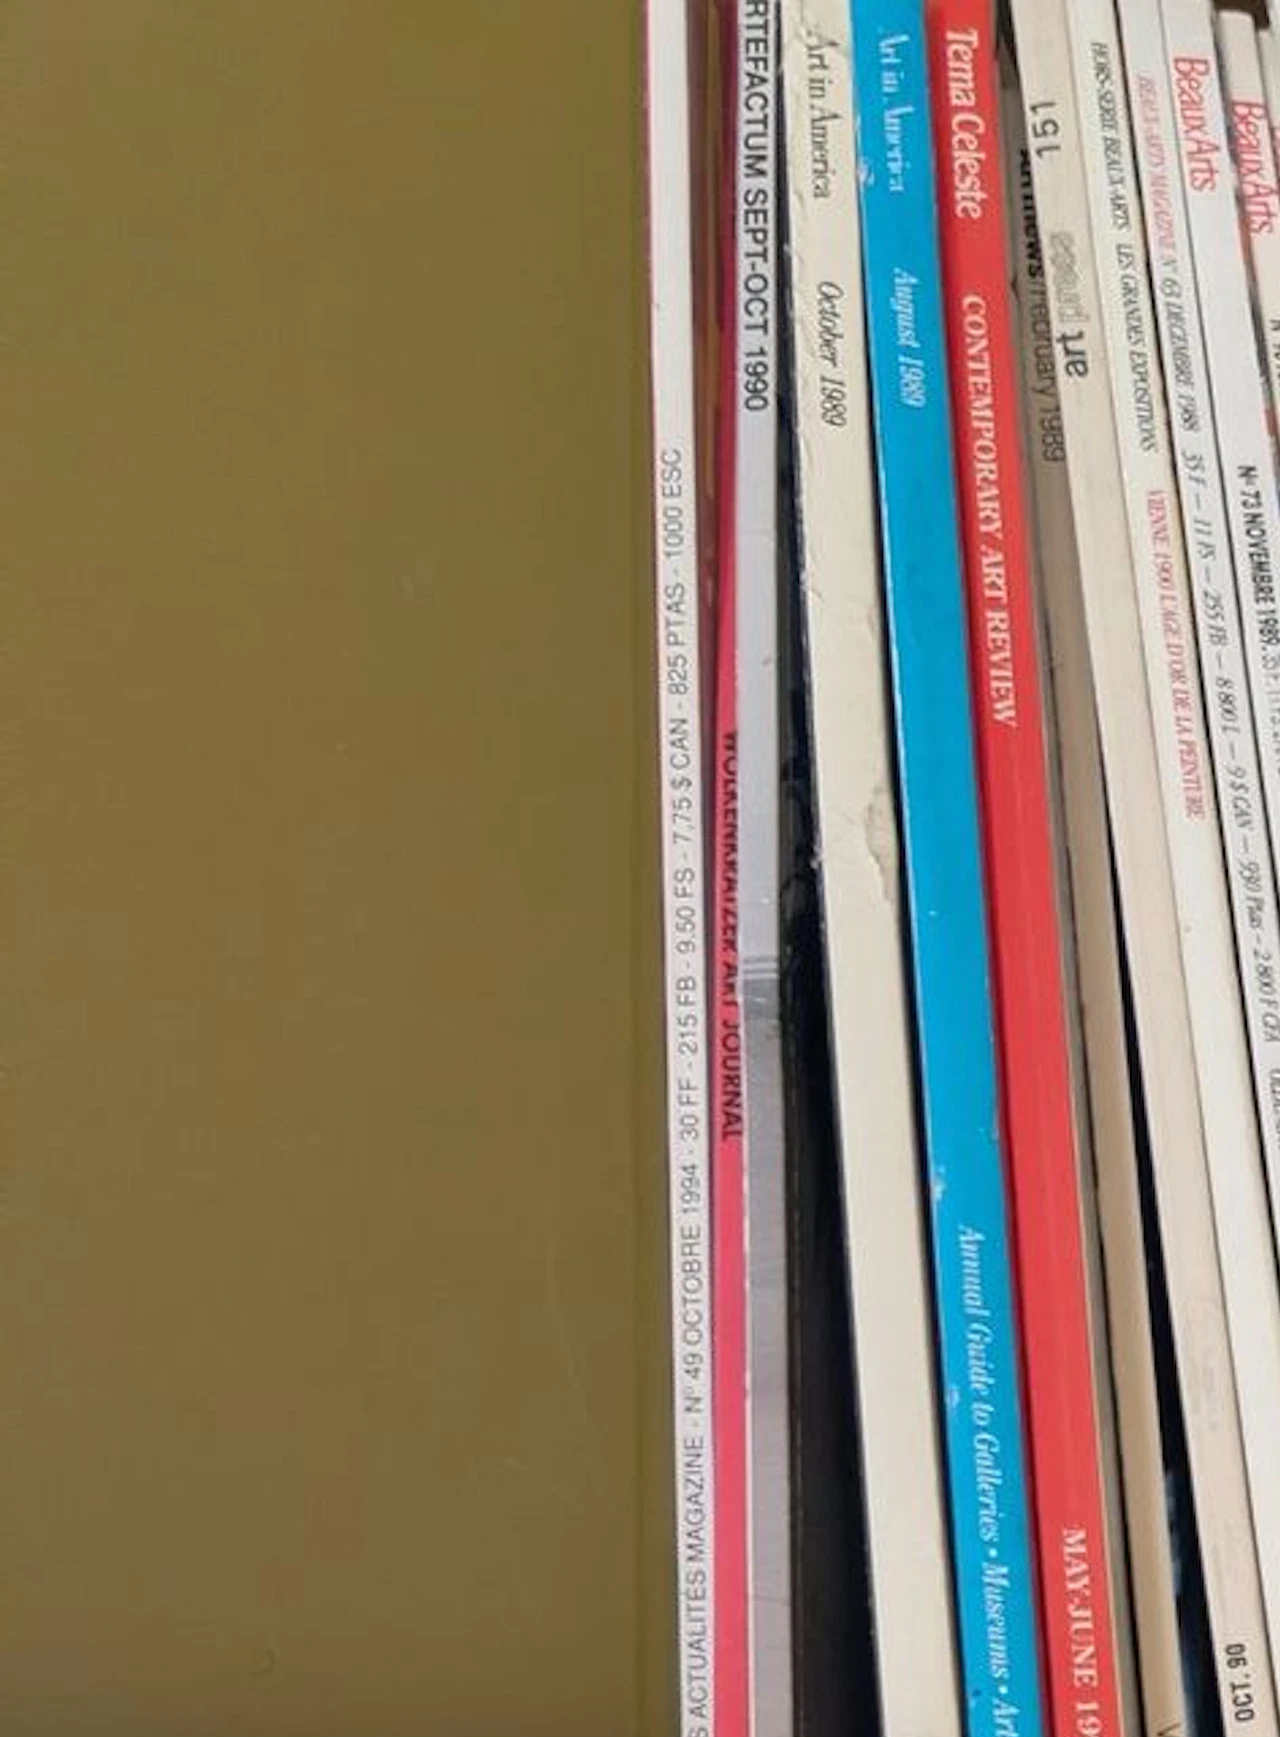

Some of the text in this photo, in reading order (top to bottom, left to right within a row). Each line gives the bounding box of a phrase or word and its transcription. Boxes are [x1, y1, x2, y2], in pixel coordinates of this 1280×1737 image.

[945, 29, 985, 220] Tema Celeste
[1028, 100, 1061, 159] 151
[743, 0, 770, 411] RTEFACTUM SEPT-OCT 1990
[816, 280, 847, 427] October 1989
[888, 266, 926, 411] August 1989
[1055, 329, 1089, 377] art
[963, 294, 1016, 727] CONTEMPORARY ART REVIEW
[678, 1162, 701, 1215] 1994
[678, 1223, 704, 1346] OCTOBRE
[681, 1351, 704, 1381] 49
[681, 1434, 706, 1563] MAGAZINE
[1062, 1529, 1098, 1687] MAY-JUNE
